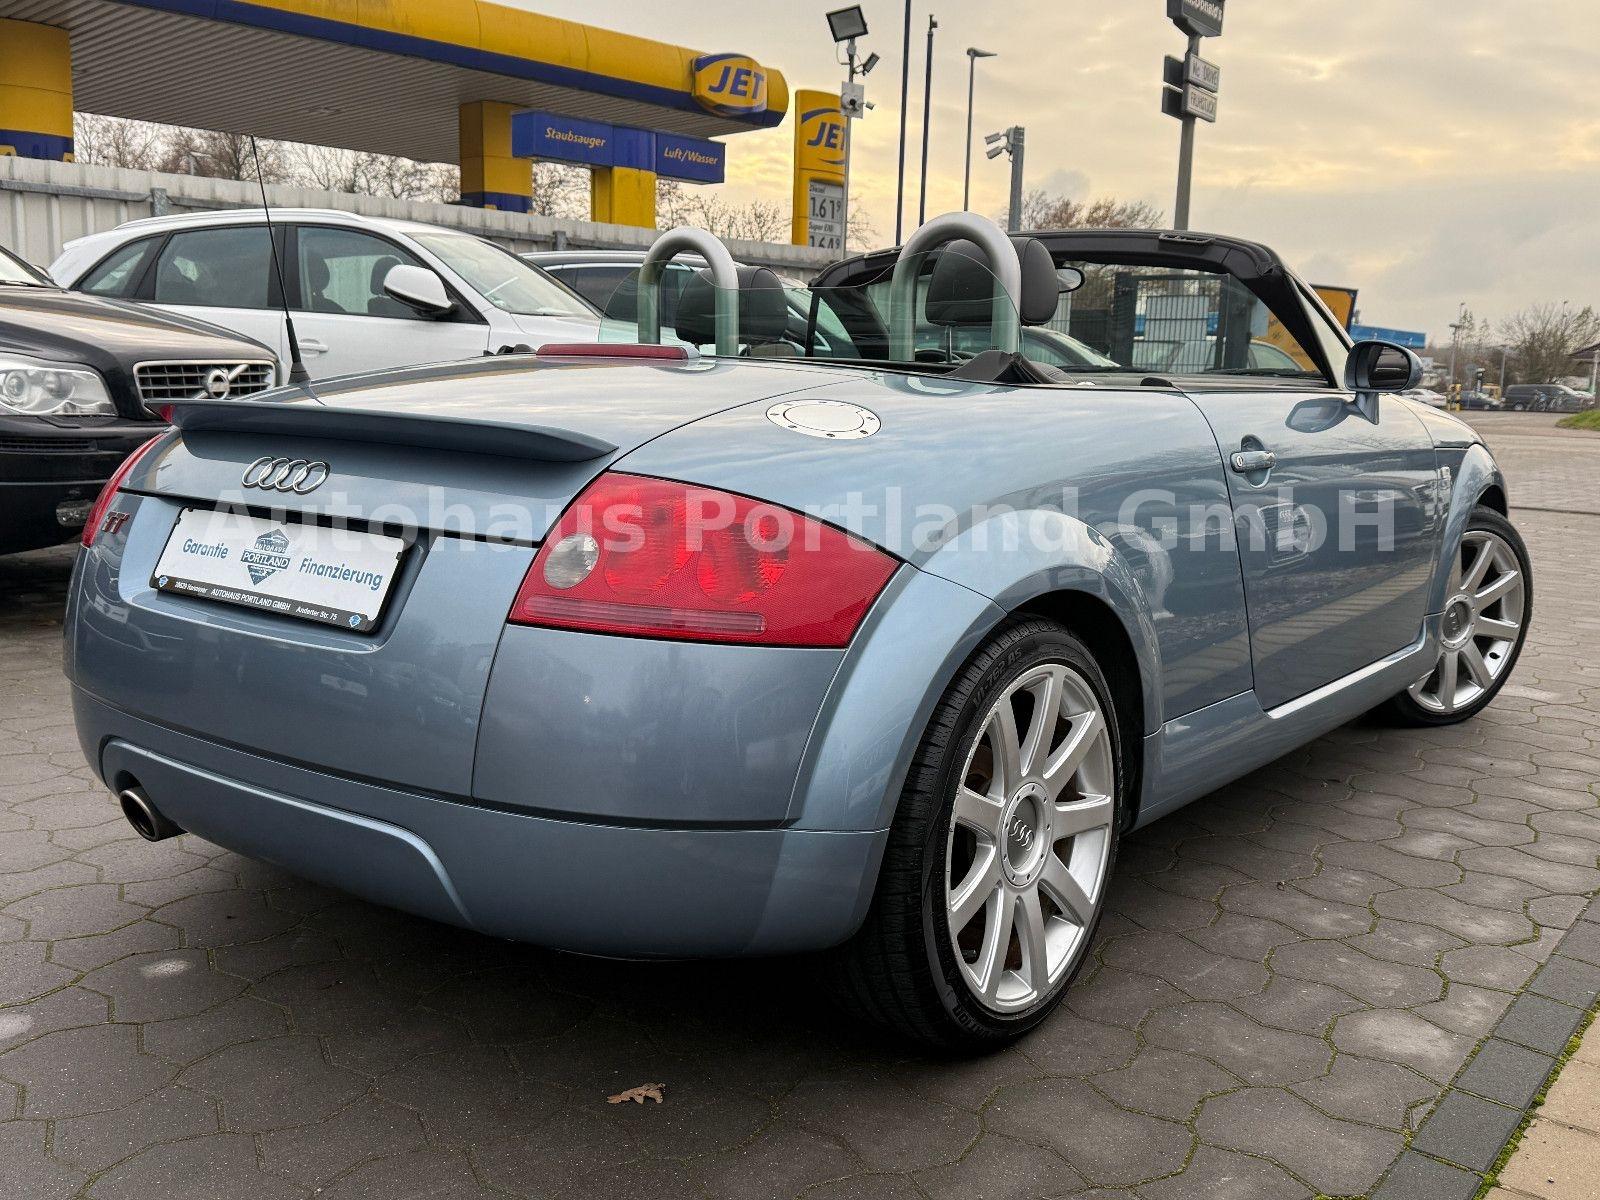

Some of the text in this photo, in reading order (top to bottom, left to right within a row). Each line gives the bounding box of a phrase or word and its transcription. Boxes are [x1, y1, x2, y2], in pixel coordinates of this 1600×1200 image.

[708, 65, 765, 100] JET
[545, 127, 607, 149] Staubsauger
[664, 147, 719, 166] Luft/Wasser
[182, 538, 229, 560] Garantie
[254, 543, 287, 554] AUTOHAUS
[242, 550, 290, 569] PORTLAND
[299, 557, 384, 591] Finanzierung
[210, 588, 241, 601] AUTOHAUS
[241, 594, 272, 607] PORTLAND
